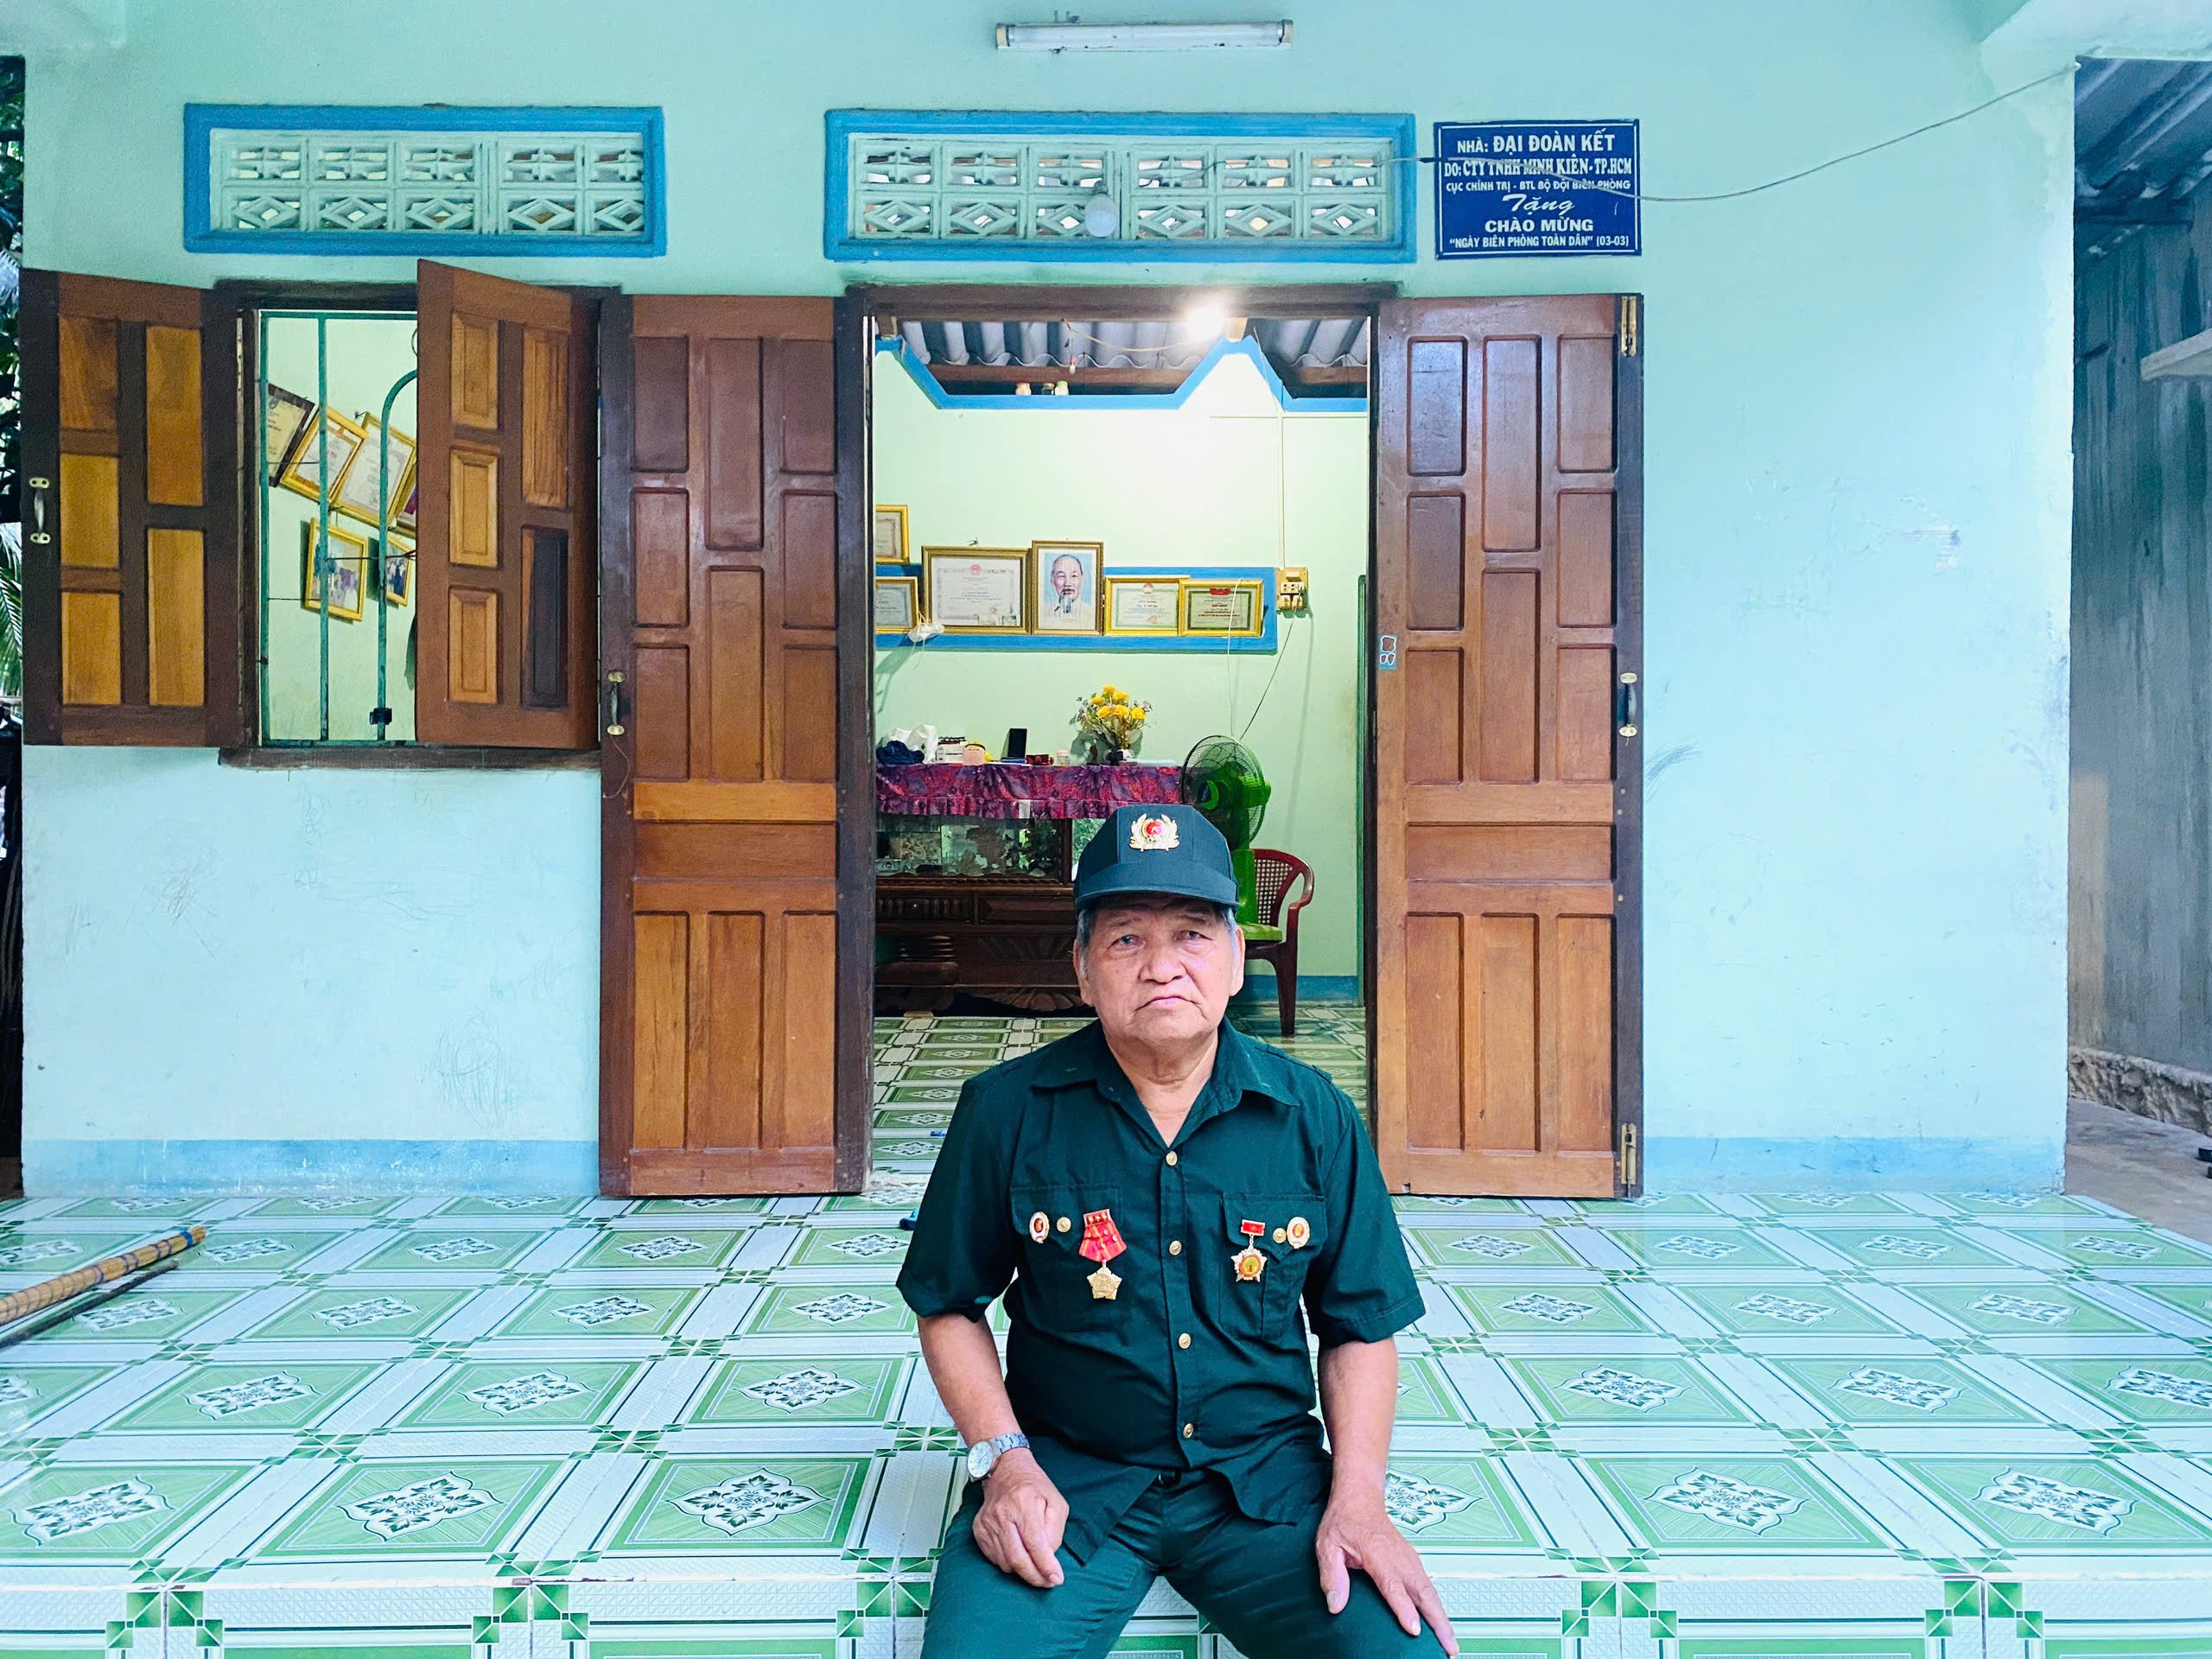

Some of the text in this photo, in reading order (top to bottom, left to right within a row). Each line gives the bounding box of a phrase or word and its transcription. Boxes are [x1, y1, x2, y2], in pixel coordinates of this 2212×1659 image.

[1457, 128, 1616, 156] NHÀ: ĐẠI ĐOÀN KẾT
[1444, 162, 1462, 177] DO:
[1463, 160, 1485, 176] CTY
[1488, 159, 1521, 176] TNHH
[1523, 158, 1554, 175] MINH
[1446, 182, 1463, 194] CỤC
[1465, 180, 1494, 191] CHÍNH
[1496, 181, 1511, 193] TRỊ
[1520, 181, 1535, 190] BTL
[1538, 179, 1551, 192] BỘ
[1553, 179, 1570, 192] ĐỘI
[1503, 194, 1575, 216] Tặng
[1484, 215, 1594, 232] CHÀO MỪNG
[1483, 234, 1504, 247] BIÊN
[1508, 234, 1540, 247] PHÒNG
[1541, 233, 1566, 246] TOÀN
[1596, 236, 1630, 247] (03-03)
